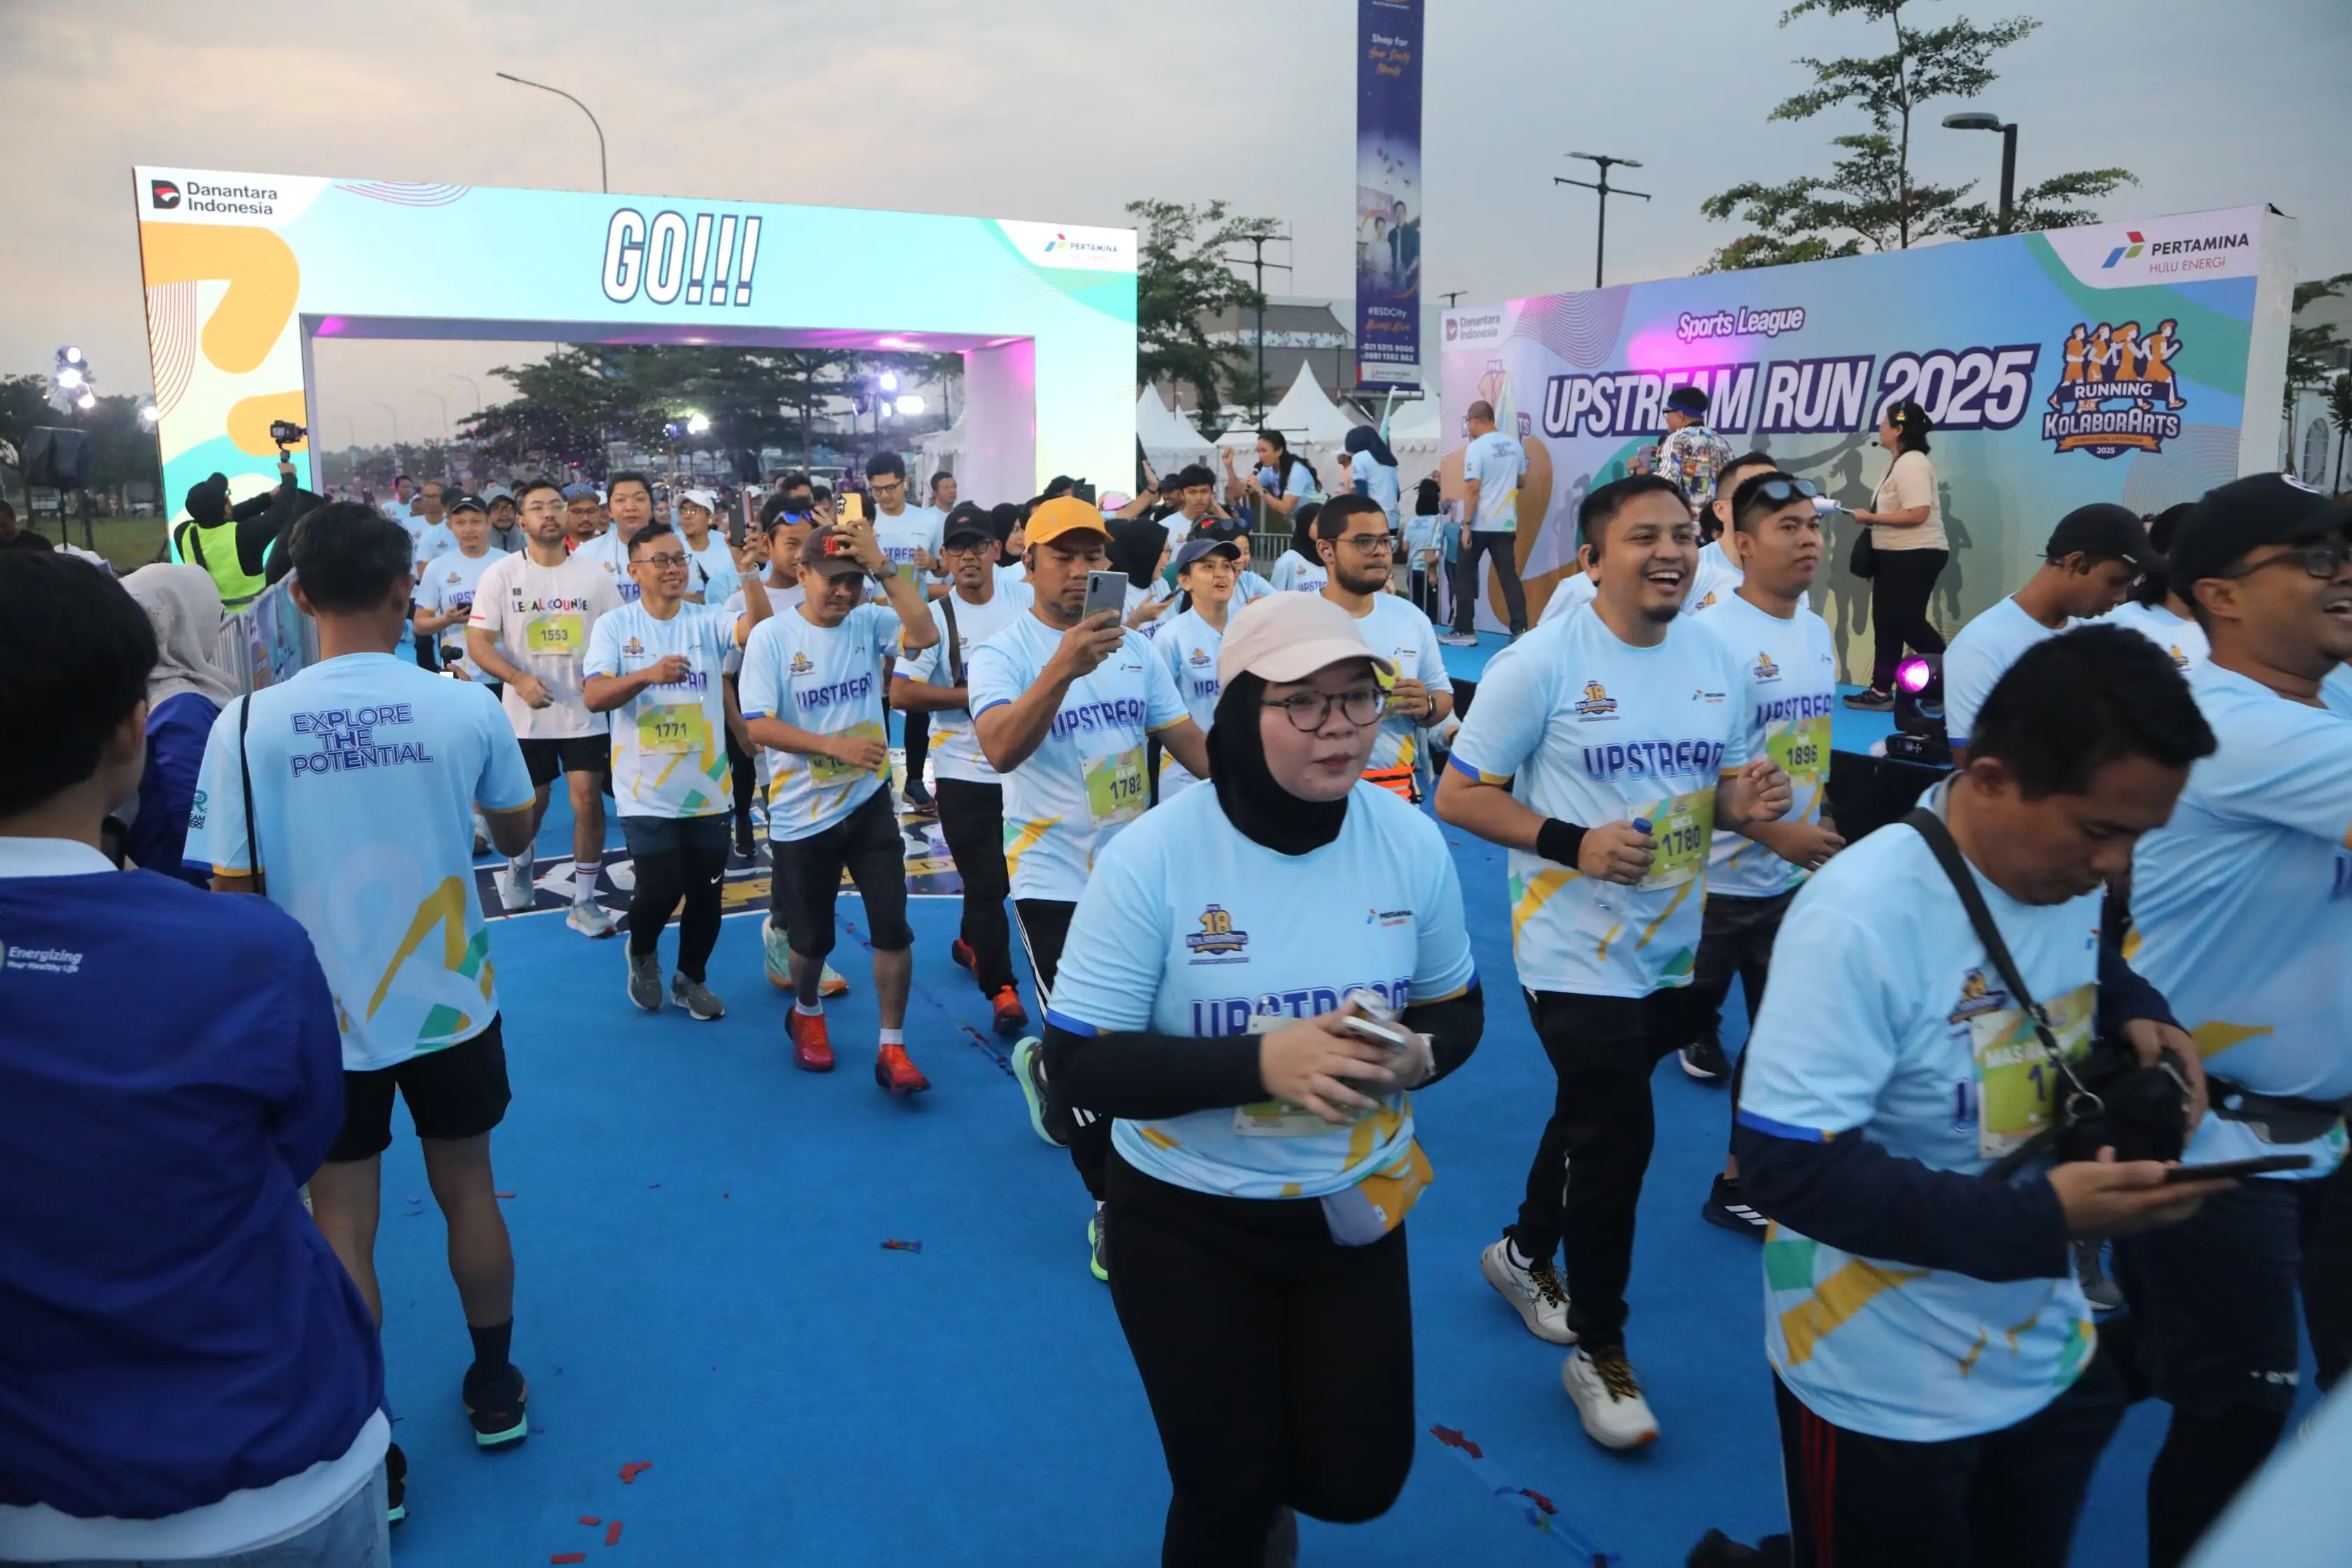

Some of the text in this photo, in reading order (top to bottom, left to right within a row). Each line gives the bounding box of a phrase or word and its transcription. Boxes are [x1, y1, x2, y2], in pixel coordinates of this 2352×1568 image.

[187, 181, 278, 200] Danantara
[188, 197, 273, 215] Indonesia
[1070, 242, 1118, 252] PERTAMINA
[2151, 233, 2249, 256] PERTAMINA
[602, 207, 763, 307] GO!!!
[2150, 256, 2226, 274] HULU ENERGI
[1367, 307, 1407, 318] #BSDCity
[1460, 315, 1501, 328] Danantara
[1460, 326, 1498, 341] Indonesia
[1677, 306, 1805, 344] Sports League
[1543, 345, 2039, 436] UPSTREAM RUN 2025
[2075, 382, 2152, 398] RUNNING
[512, 598, 545, 612] LEGAL
[540, 629, 568, 640] 1553
[291, 704, 413, 734] EXPLORE
[655, 722, 687, 737] 1771
[316, 727, 374, 752] THE
[290, 742, 433, 777] POTENTIAL
[1786, 744, 1818, 766] 1896
[1110, 773, 1142, 799] 1782
[1662, 825, 1701, 857] 1780
[1198, 909, 1232, 935] 18
[8, 946, 83, 965] Energizing
